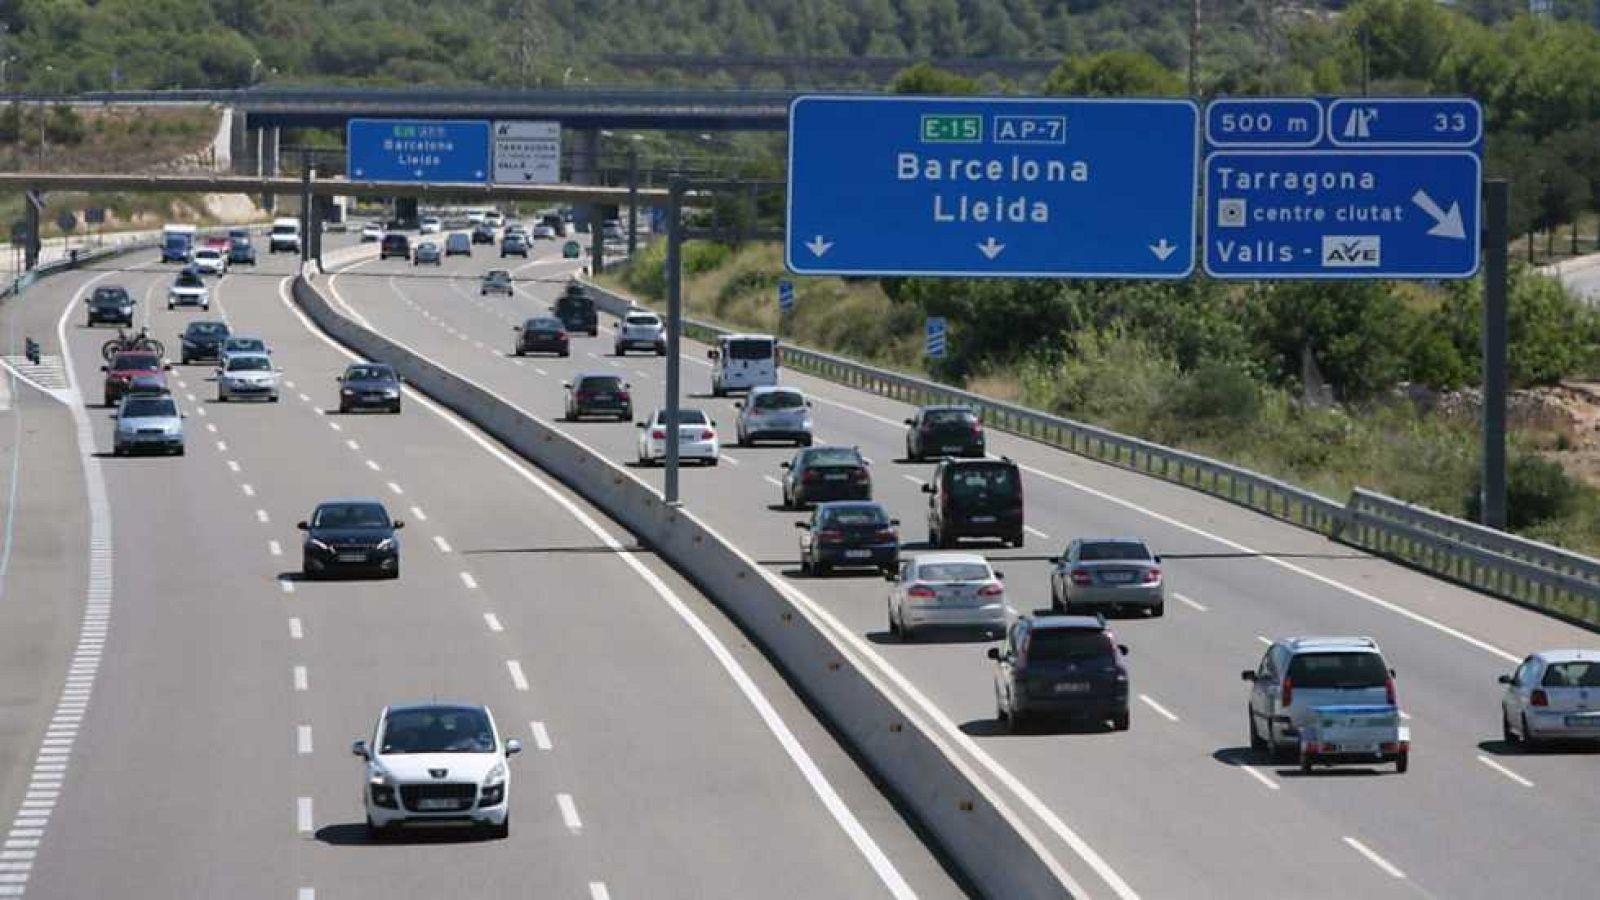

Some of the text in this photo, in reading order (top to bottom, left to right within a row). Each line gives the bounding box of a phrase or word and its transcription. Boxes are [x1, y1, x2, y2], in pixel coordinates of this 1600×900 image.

[925, 118, 1060, 139] E-15 AP-7
[1221, 113, 1308, 132] 500 m
[1434, 113, 1466, 132] 33
[898, 153, 1088, 182] Barcelona
[1217, 167, 1375, 195] Tarragona
[933, 195, 1049, 222] Lleida
[1253, 204, 1403, 222] centre ciutat
[1216, 240, 1294, 262] Valls
[1326, 240, 1377, 263] AVE
